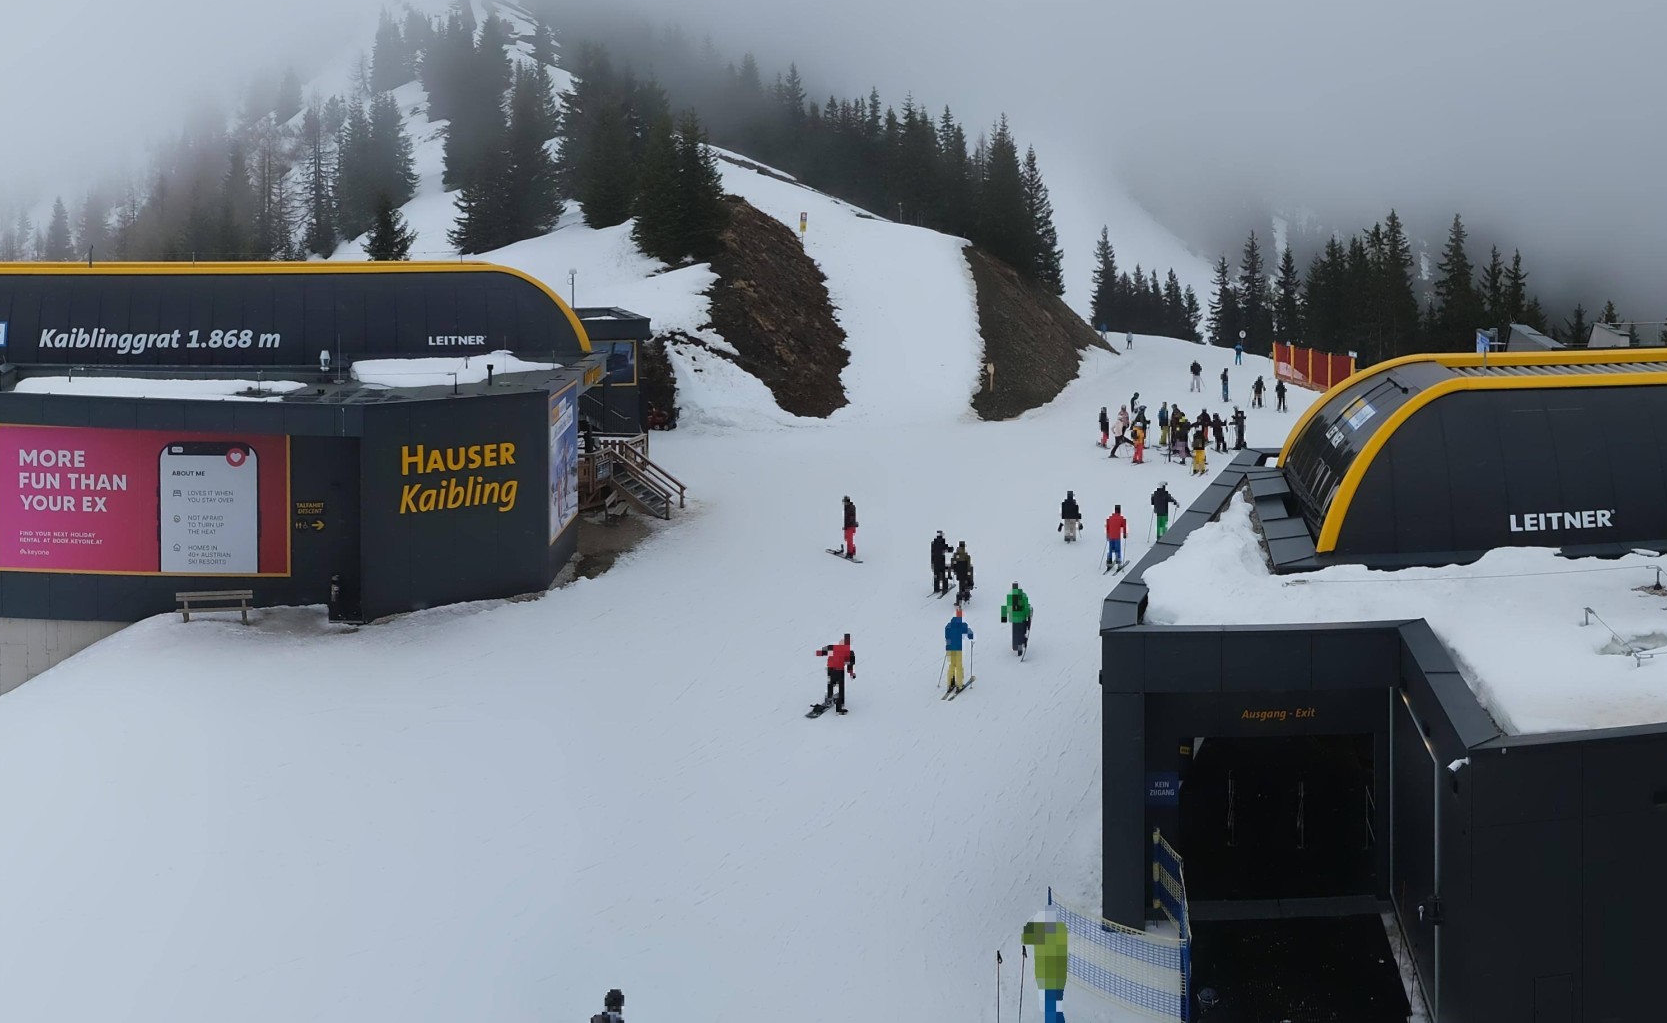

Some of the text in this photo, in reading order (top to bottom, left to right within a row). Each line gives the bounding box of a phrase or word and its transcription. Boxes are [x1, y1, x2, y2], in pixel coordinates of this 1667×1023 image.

[38, 328, 281, 355] Kaiblinggrat 1.868 m
[428, 335, 485, 346] LEITNER
[19, 449, 86, 468] MORE
[401, 442, 516, 476] HAUSER
[19, 472, 127, 491] FUN THAN
[20, 495, 108, 512] YOUR EX
[399, 476, 518, 514] Kaibling
[1509, 510, 1614, 532] LEITNER
[27, 548, 50, 556] keyone
[1241, 709, 1287, 721] Ausgang
[1295, 707, 1315, 717] Exit
